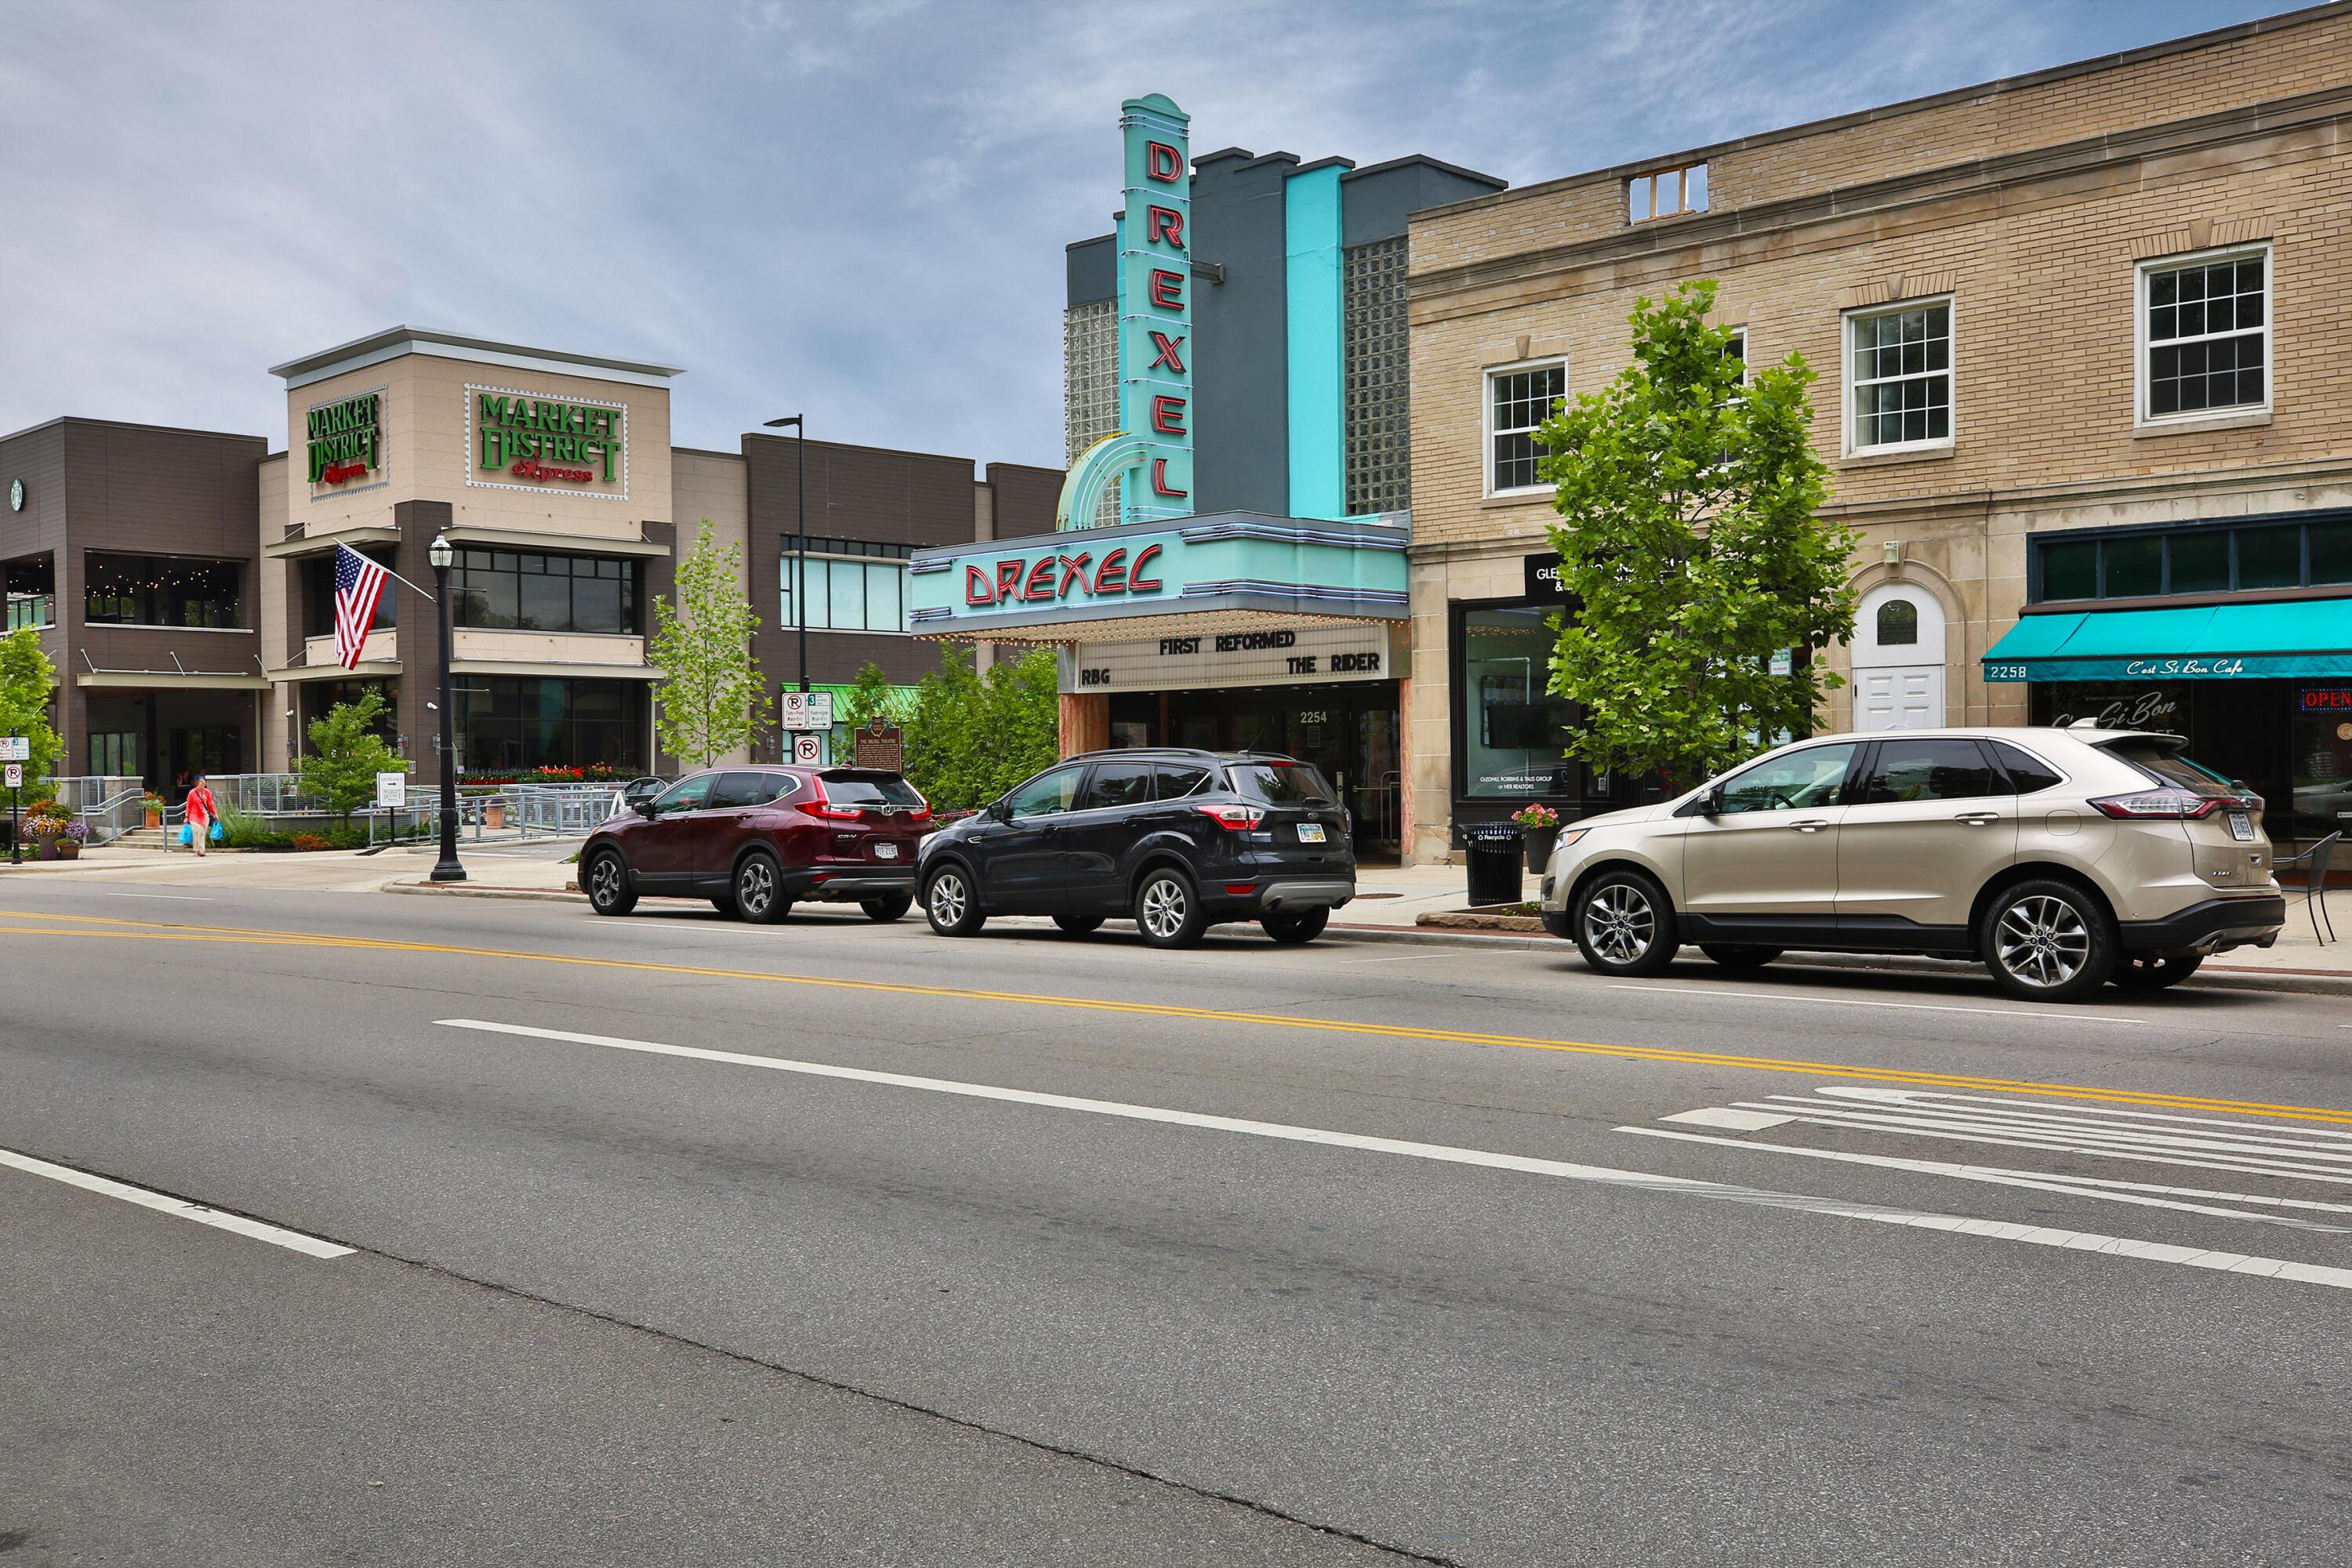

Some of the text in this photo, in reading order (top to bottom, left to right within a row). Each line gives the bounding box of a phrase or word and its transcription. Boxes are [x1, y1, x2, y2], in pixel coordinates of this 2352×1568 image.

[1145, 140, 1187, 498] DREXEL
[307, 394, 379, 440] MARKET
[478, 394, 621, 439] MARKET
[307, 426, 379, 483] DISTRICT
[479, 426, 622, 481] DISTRICT
[966, 544, 1163, 605] DREXEL
[1160, 630, 1295, 655] FIRST REFORMED
[1287, 652, 1380, 674] THE RIDER
[1991, 666, 2027, 678] 2258
[2126, 659, 2243, 676] C'est Si Bon Cafe
[1081, 669, 1110, 685] RBG
[809, 695, 815, 705] 3
[2126, 691, 2176, 725] Bon
[2305, 691, 2351, 706] OPEN
[1301, 711, 1327, 723] 2254
